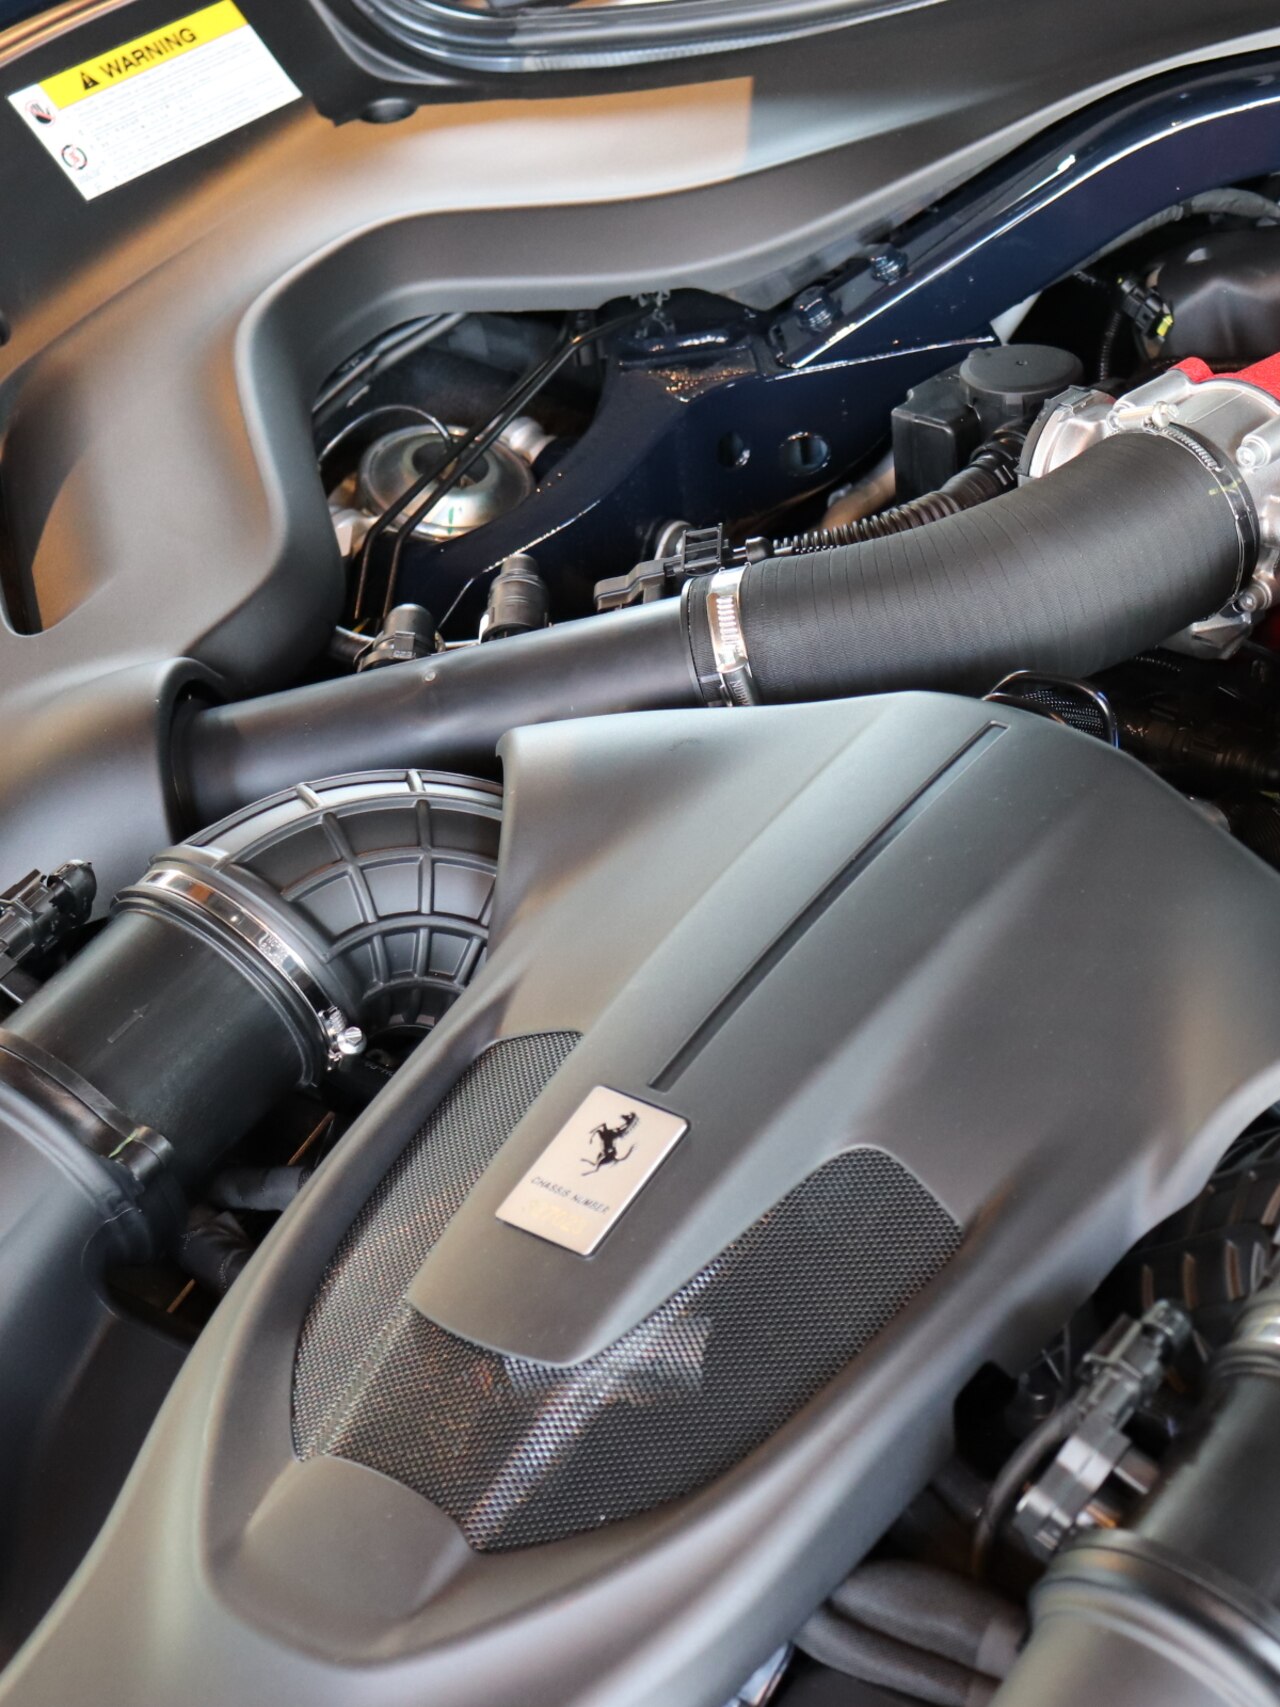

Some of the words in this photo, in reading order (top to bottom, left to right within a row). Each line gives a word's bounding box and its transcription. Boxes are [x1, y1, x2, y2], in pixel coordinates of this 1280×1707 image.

[99, 28, 197, 79] WARNING
[531, 1176, 571, 1198] CHASSIS
[572, 1194, 610, 1215] NUMBER
